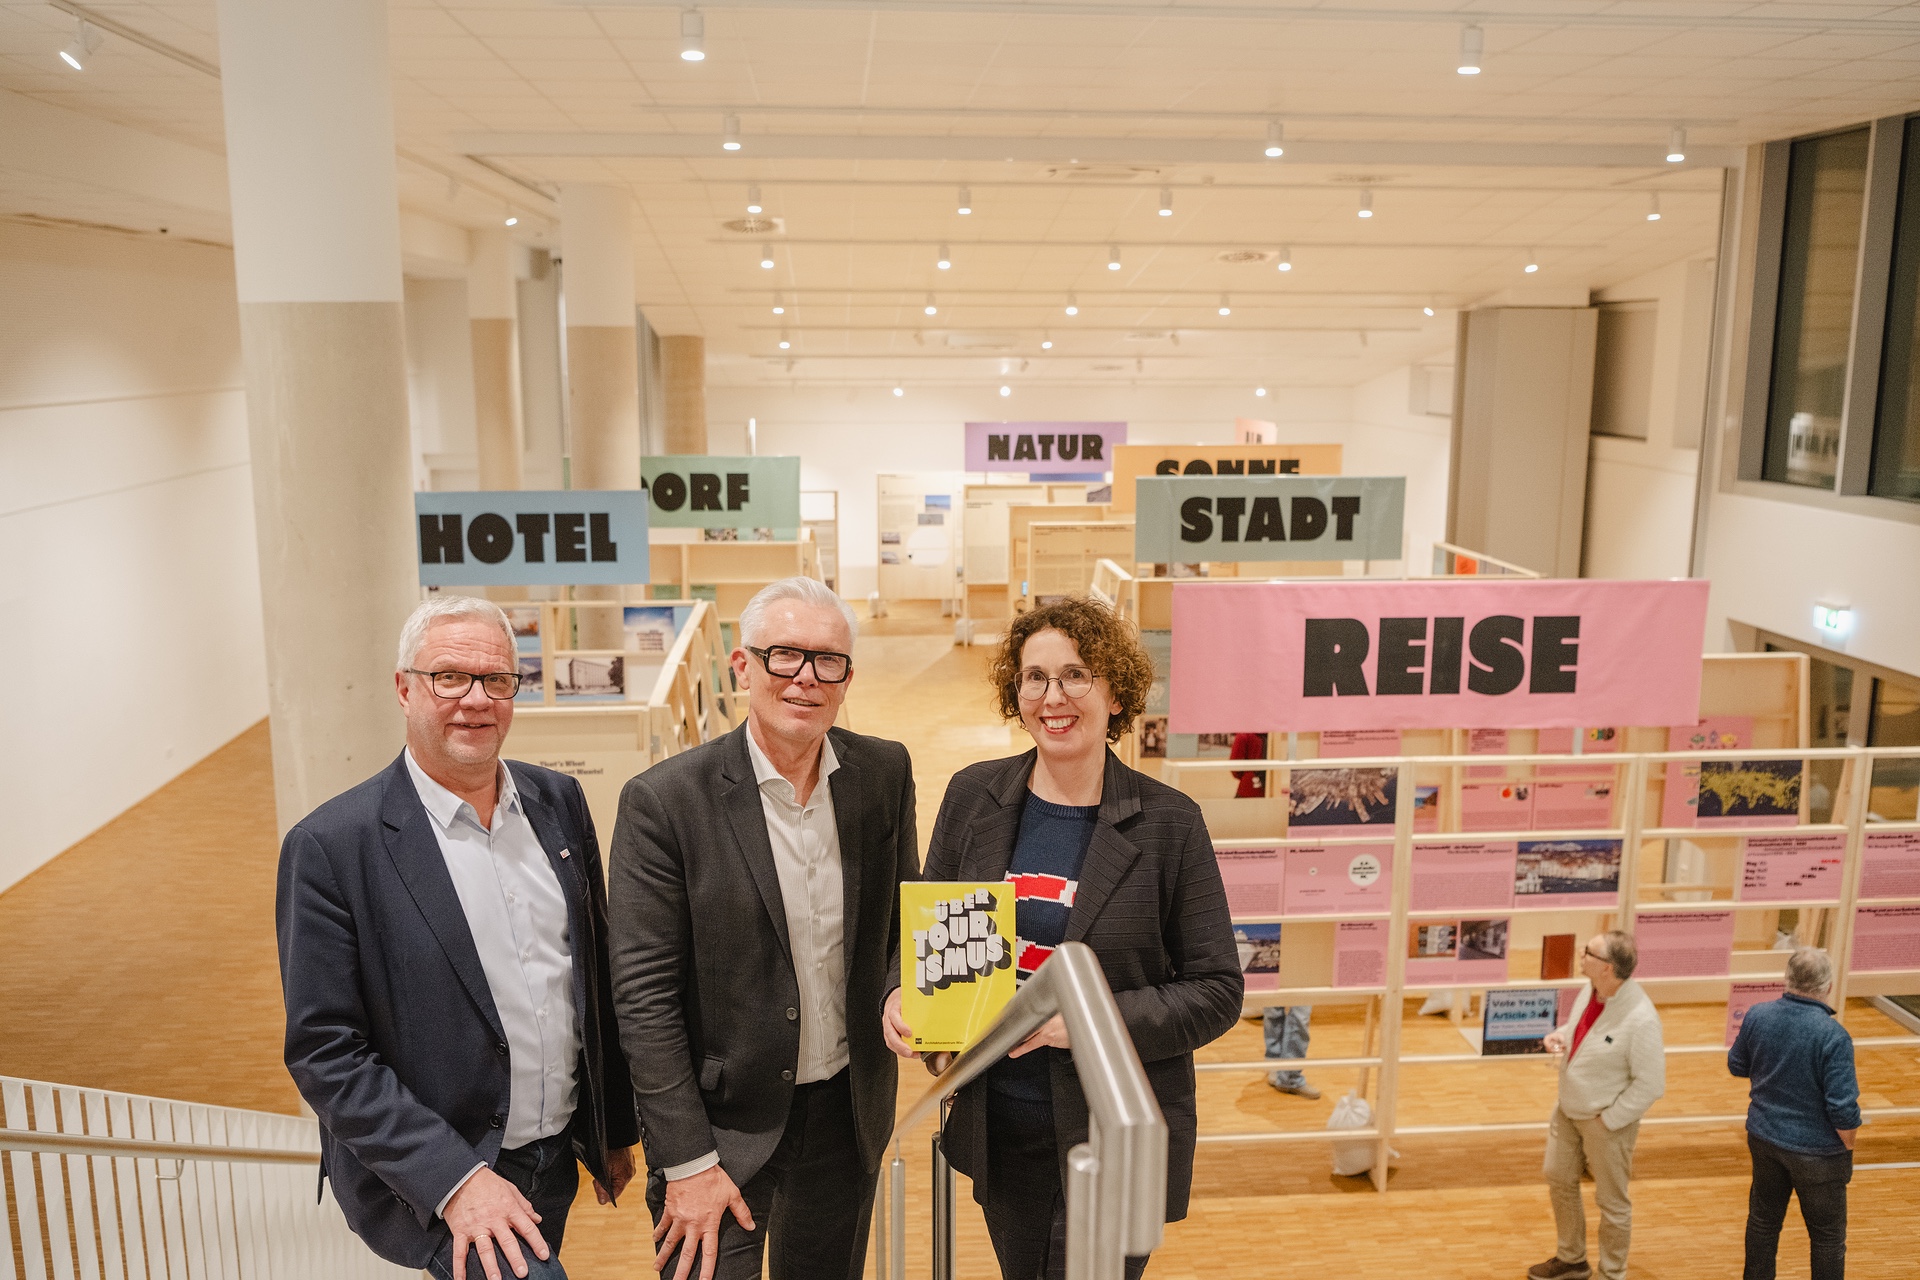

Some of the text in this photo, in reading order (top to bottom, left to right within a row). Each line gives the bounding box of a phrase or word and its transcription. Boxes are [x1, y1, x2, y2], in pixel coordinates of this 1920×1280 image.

[988, 434, 1103, 461] NATUR
[641, 472, 750, 512] ORF
[419, 512, 618, 564] HOTEL
[1181, 496, 1361, 543] STADT
[1303, 614, 1581, 697] REISE
[935, 889, 990, 922] ÜBER
[913, 910, 990, 957] TOUR
[915, 934, 1004, 988] ISMUS
[1492, 998, 1553, 1008] Vote Yes On
[1493, 1010, 1527, 1020] Article
